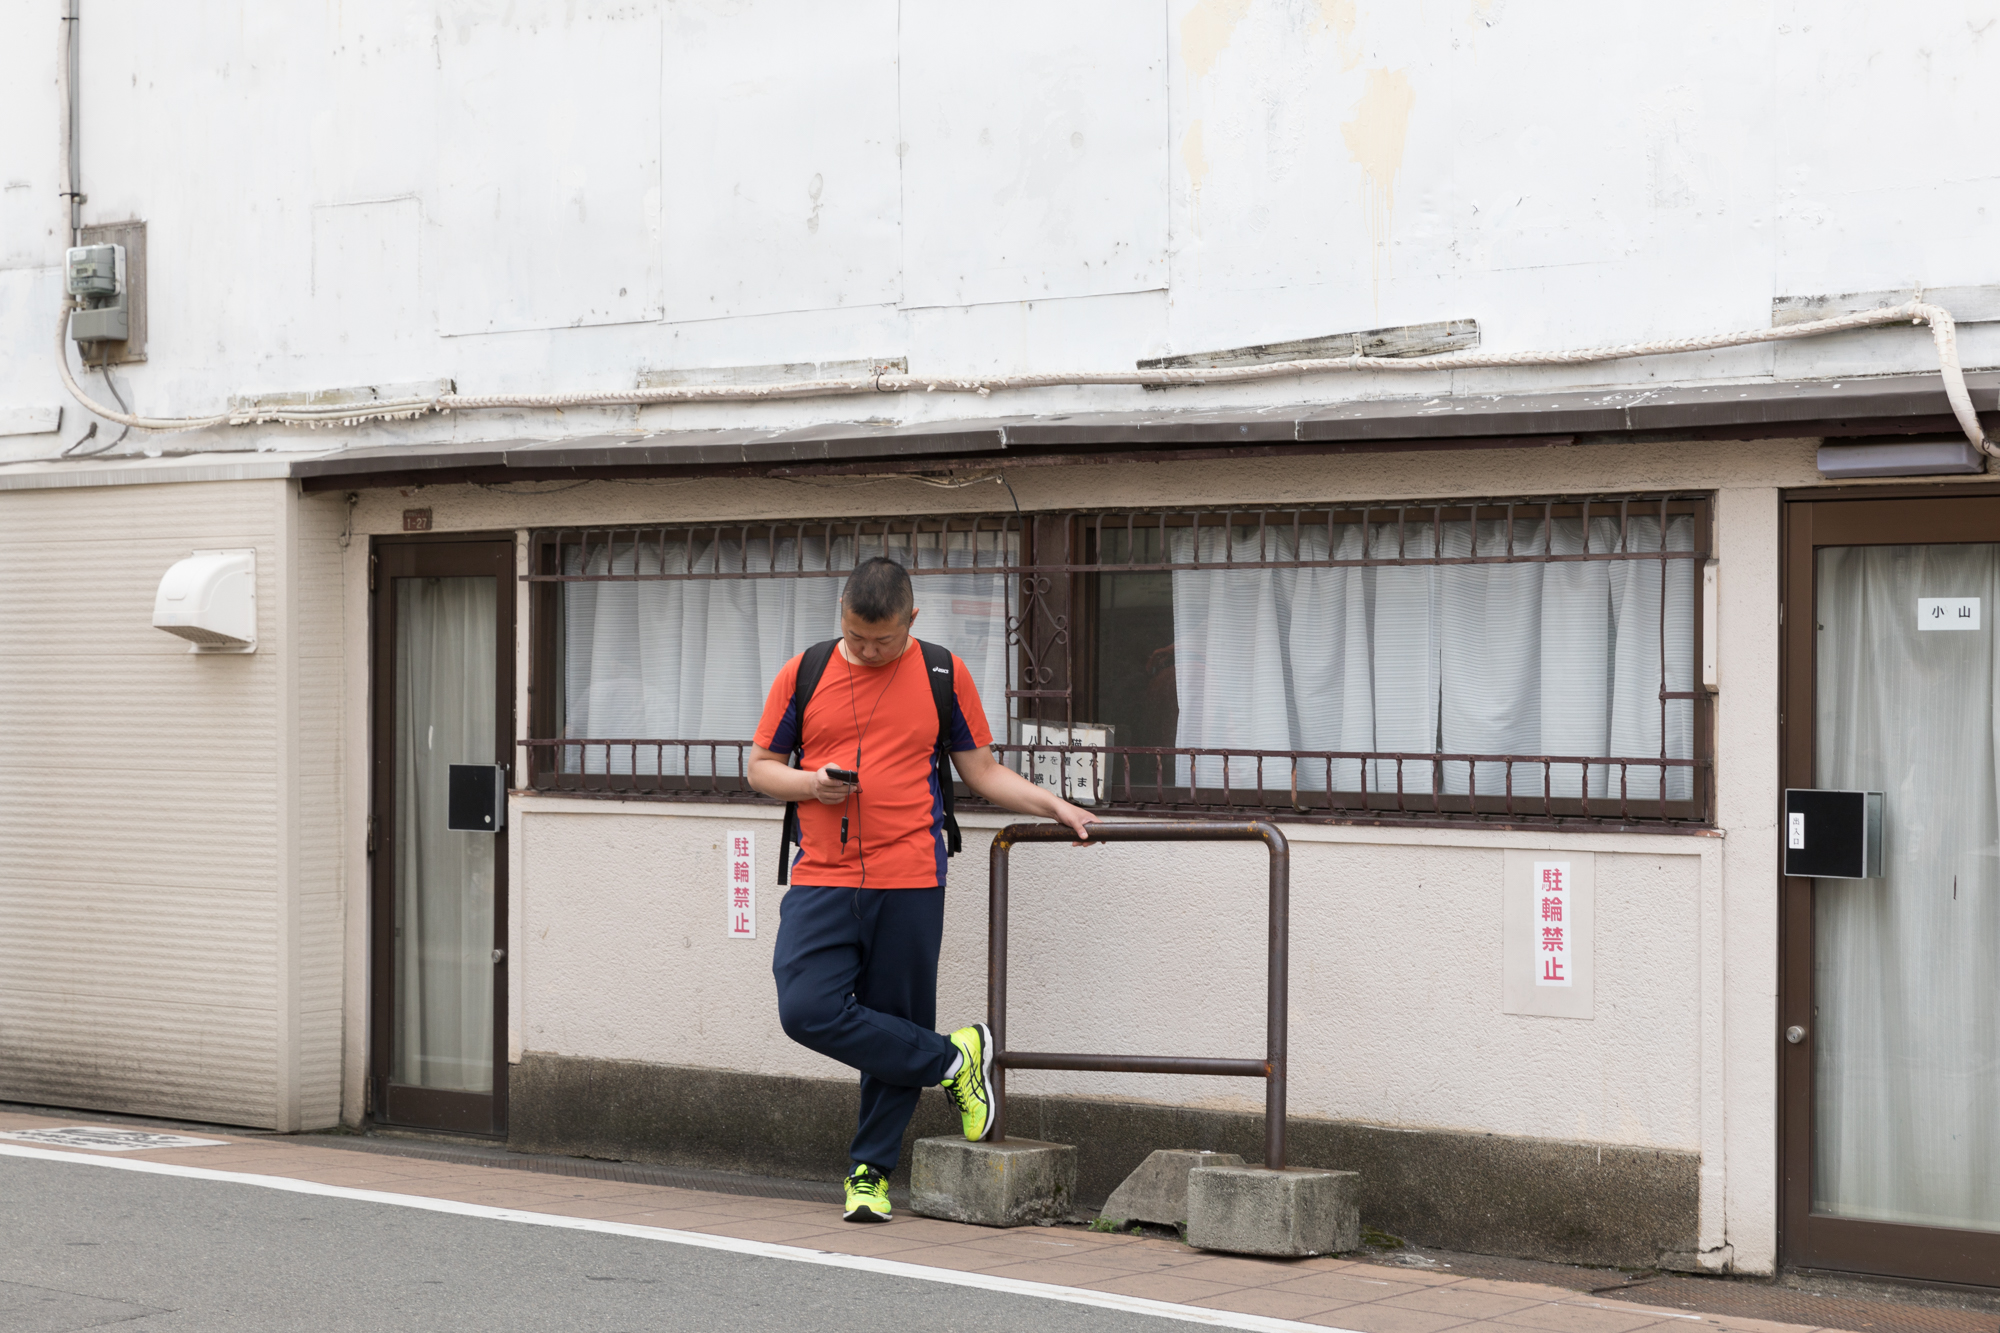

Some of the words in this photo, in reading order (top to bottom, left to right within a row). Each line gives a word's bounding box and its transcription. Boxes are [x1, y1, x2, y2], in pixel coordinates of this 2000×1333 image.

[407, 518, 427, 529] 1-27
[1932, 605, 1971, 619] 小山
[1792, 817, 1800, 846] 出入口
[733, 837, 750, 933] 駐輪禁止
[1541, 868, 1565, 981] 駐輪禁止
